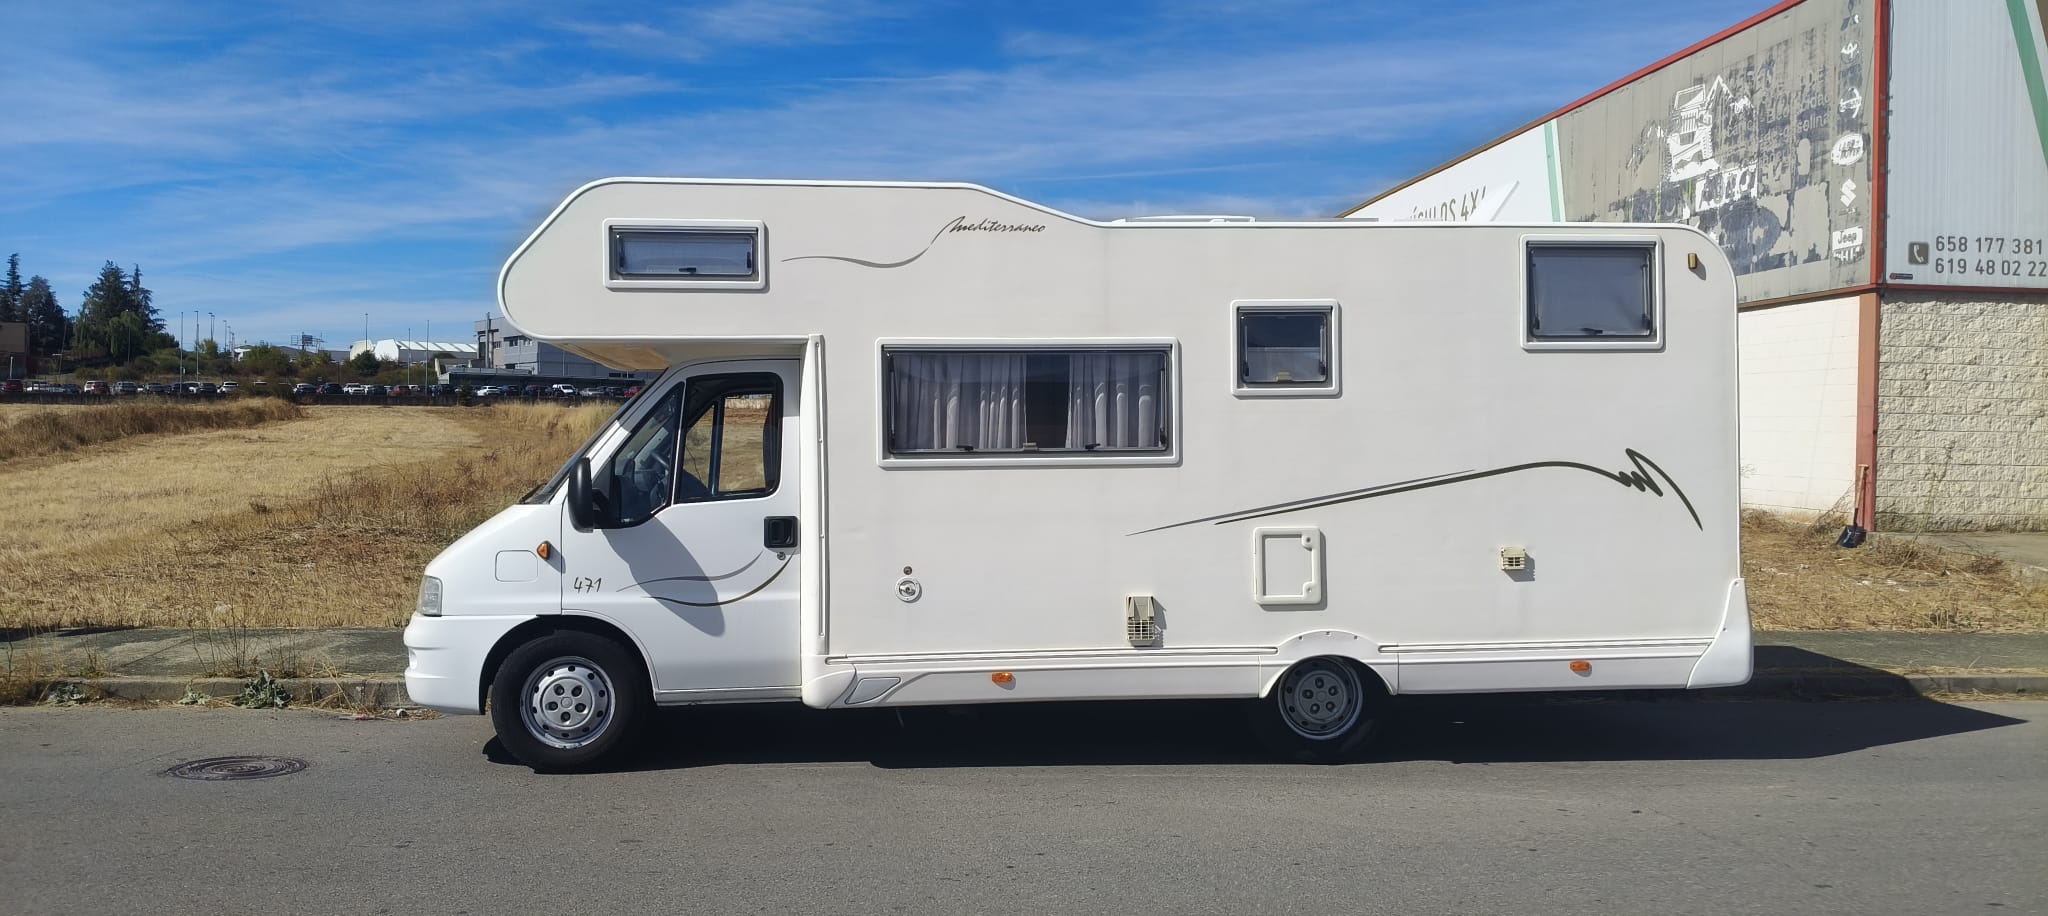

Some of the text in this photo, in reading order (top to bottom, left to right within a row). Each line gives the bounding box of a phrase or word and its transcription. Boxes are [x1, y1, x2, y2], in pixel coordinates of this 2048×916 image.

[938, 215, 1046, 234] Mediterraneo
[1837, 230, 1857, 244] Jeep
[1935, 235, 2043, 255] 658 177 381
[1935, 257, 2048, 277] 619 48 02 22
[573, 577, 602, 593] 471
